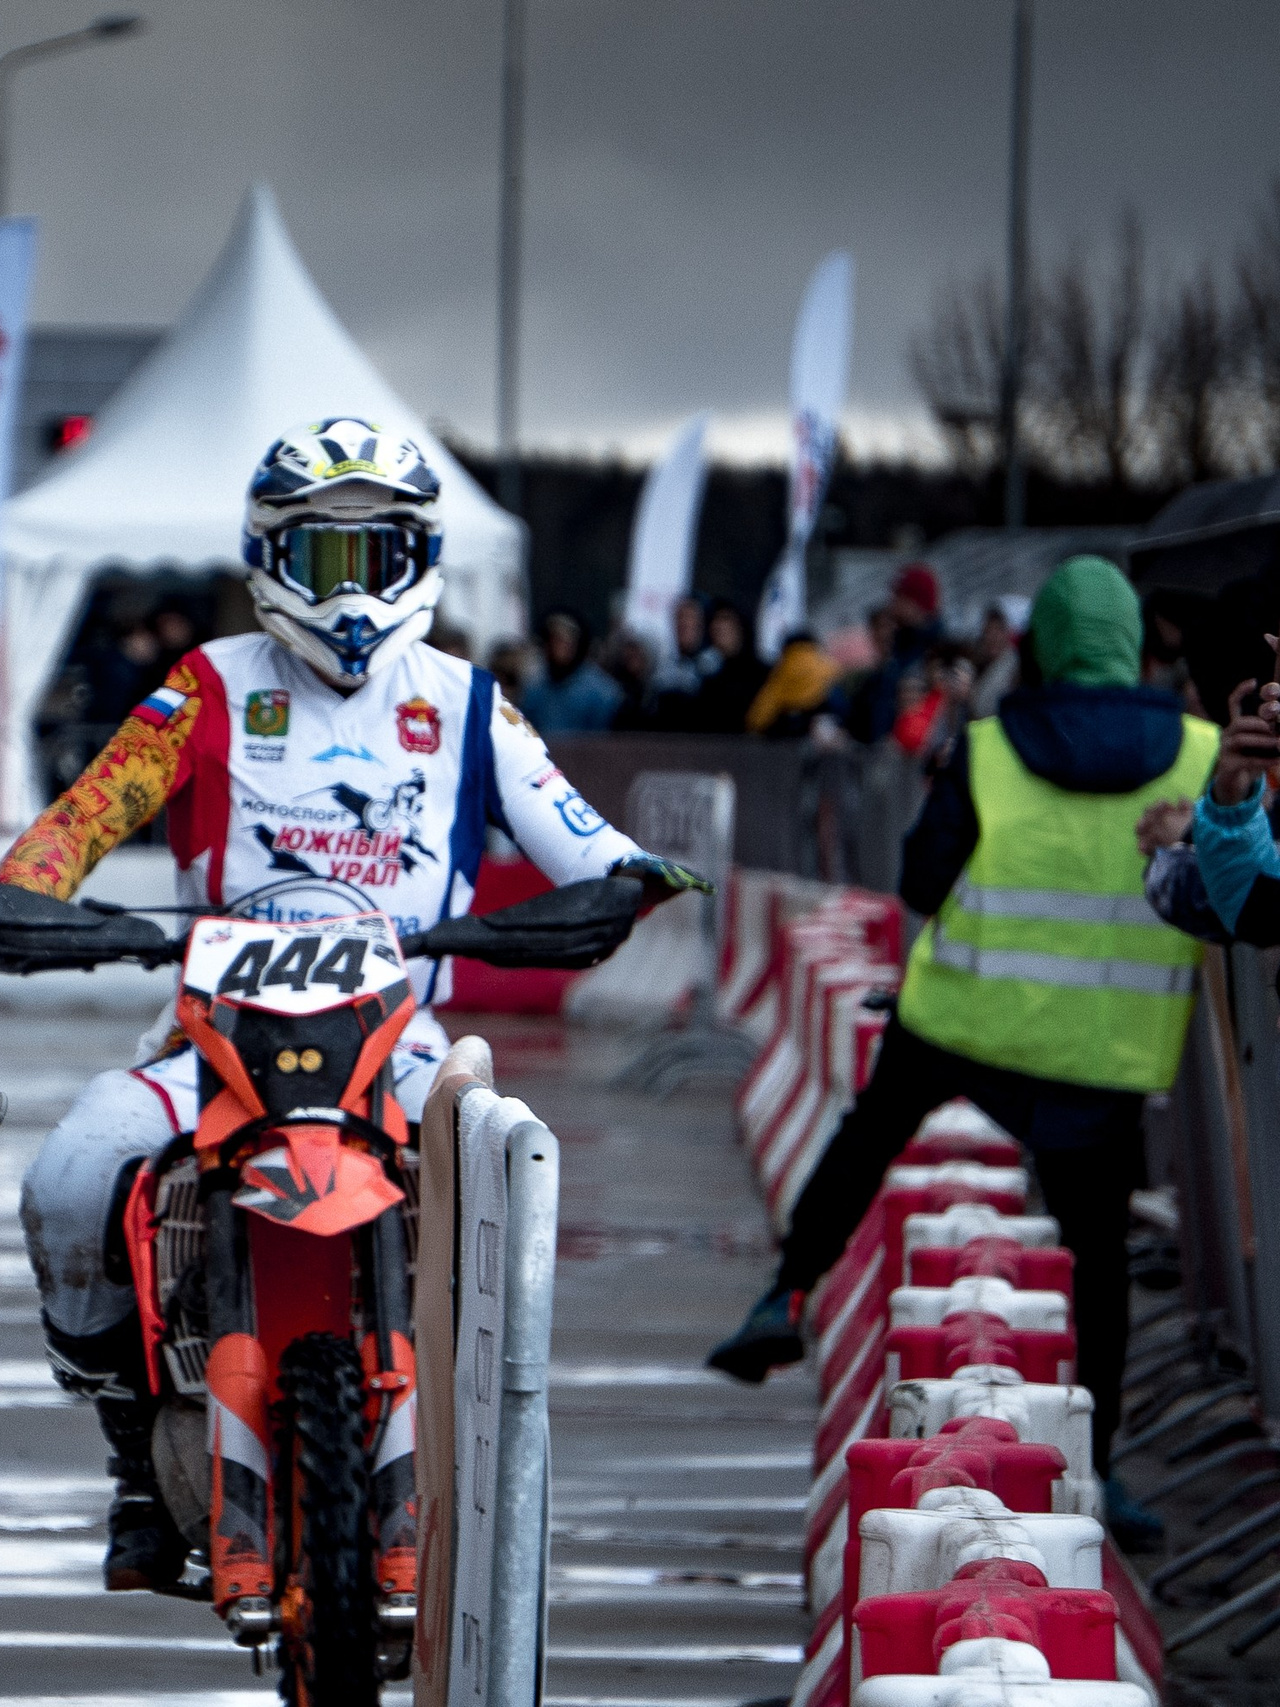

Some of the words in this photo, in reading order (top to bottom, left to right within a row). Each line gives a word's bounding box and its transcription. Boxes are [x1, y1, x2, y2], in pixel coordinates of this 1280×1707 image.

[273, 826, 403, 858] ЮЖНЫЙ
[326, 860, 404, 887] УРАЛ
[216, 936, 371, 998] 444
